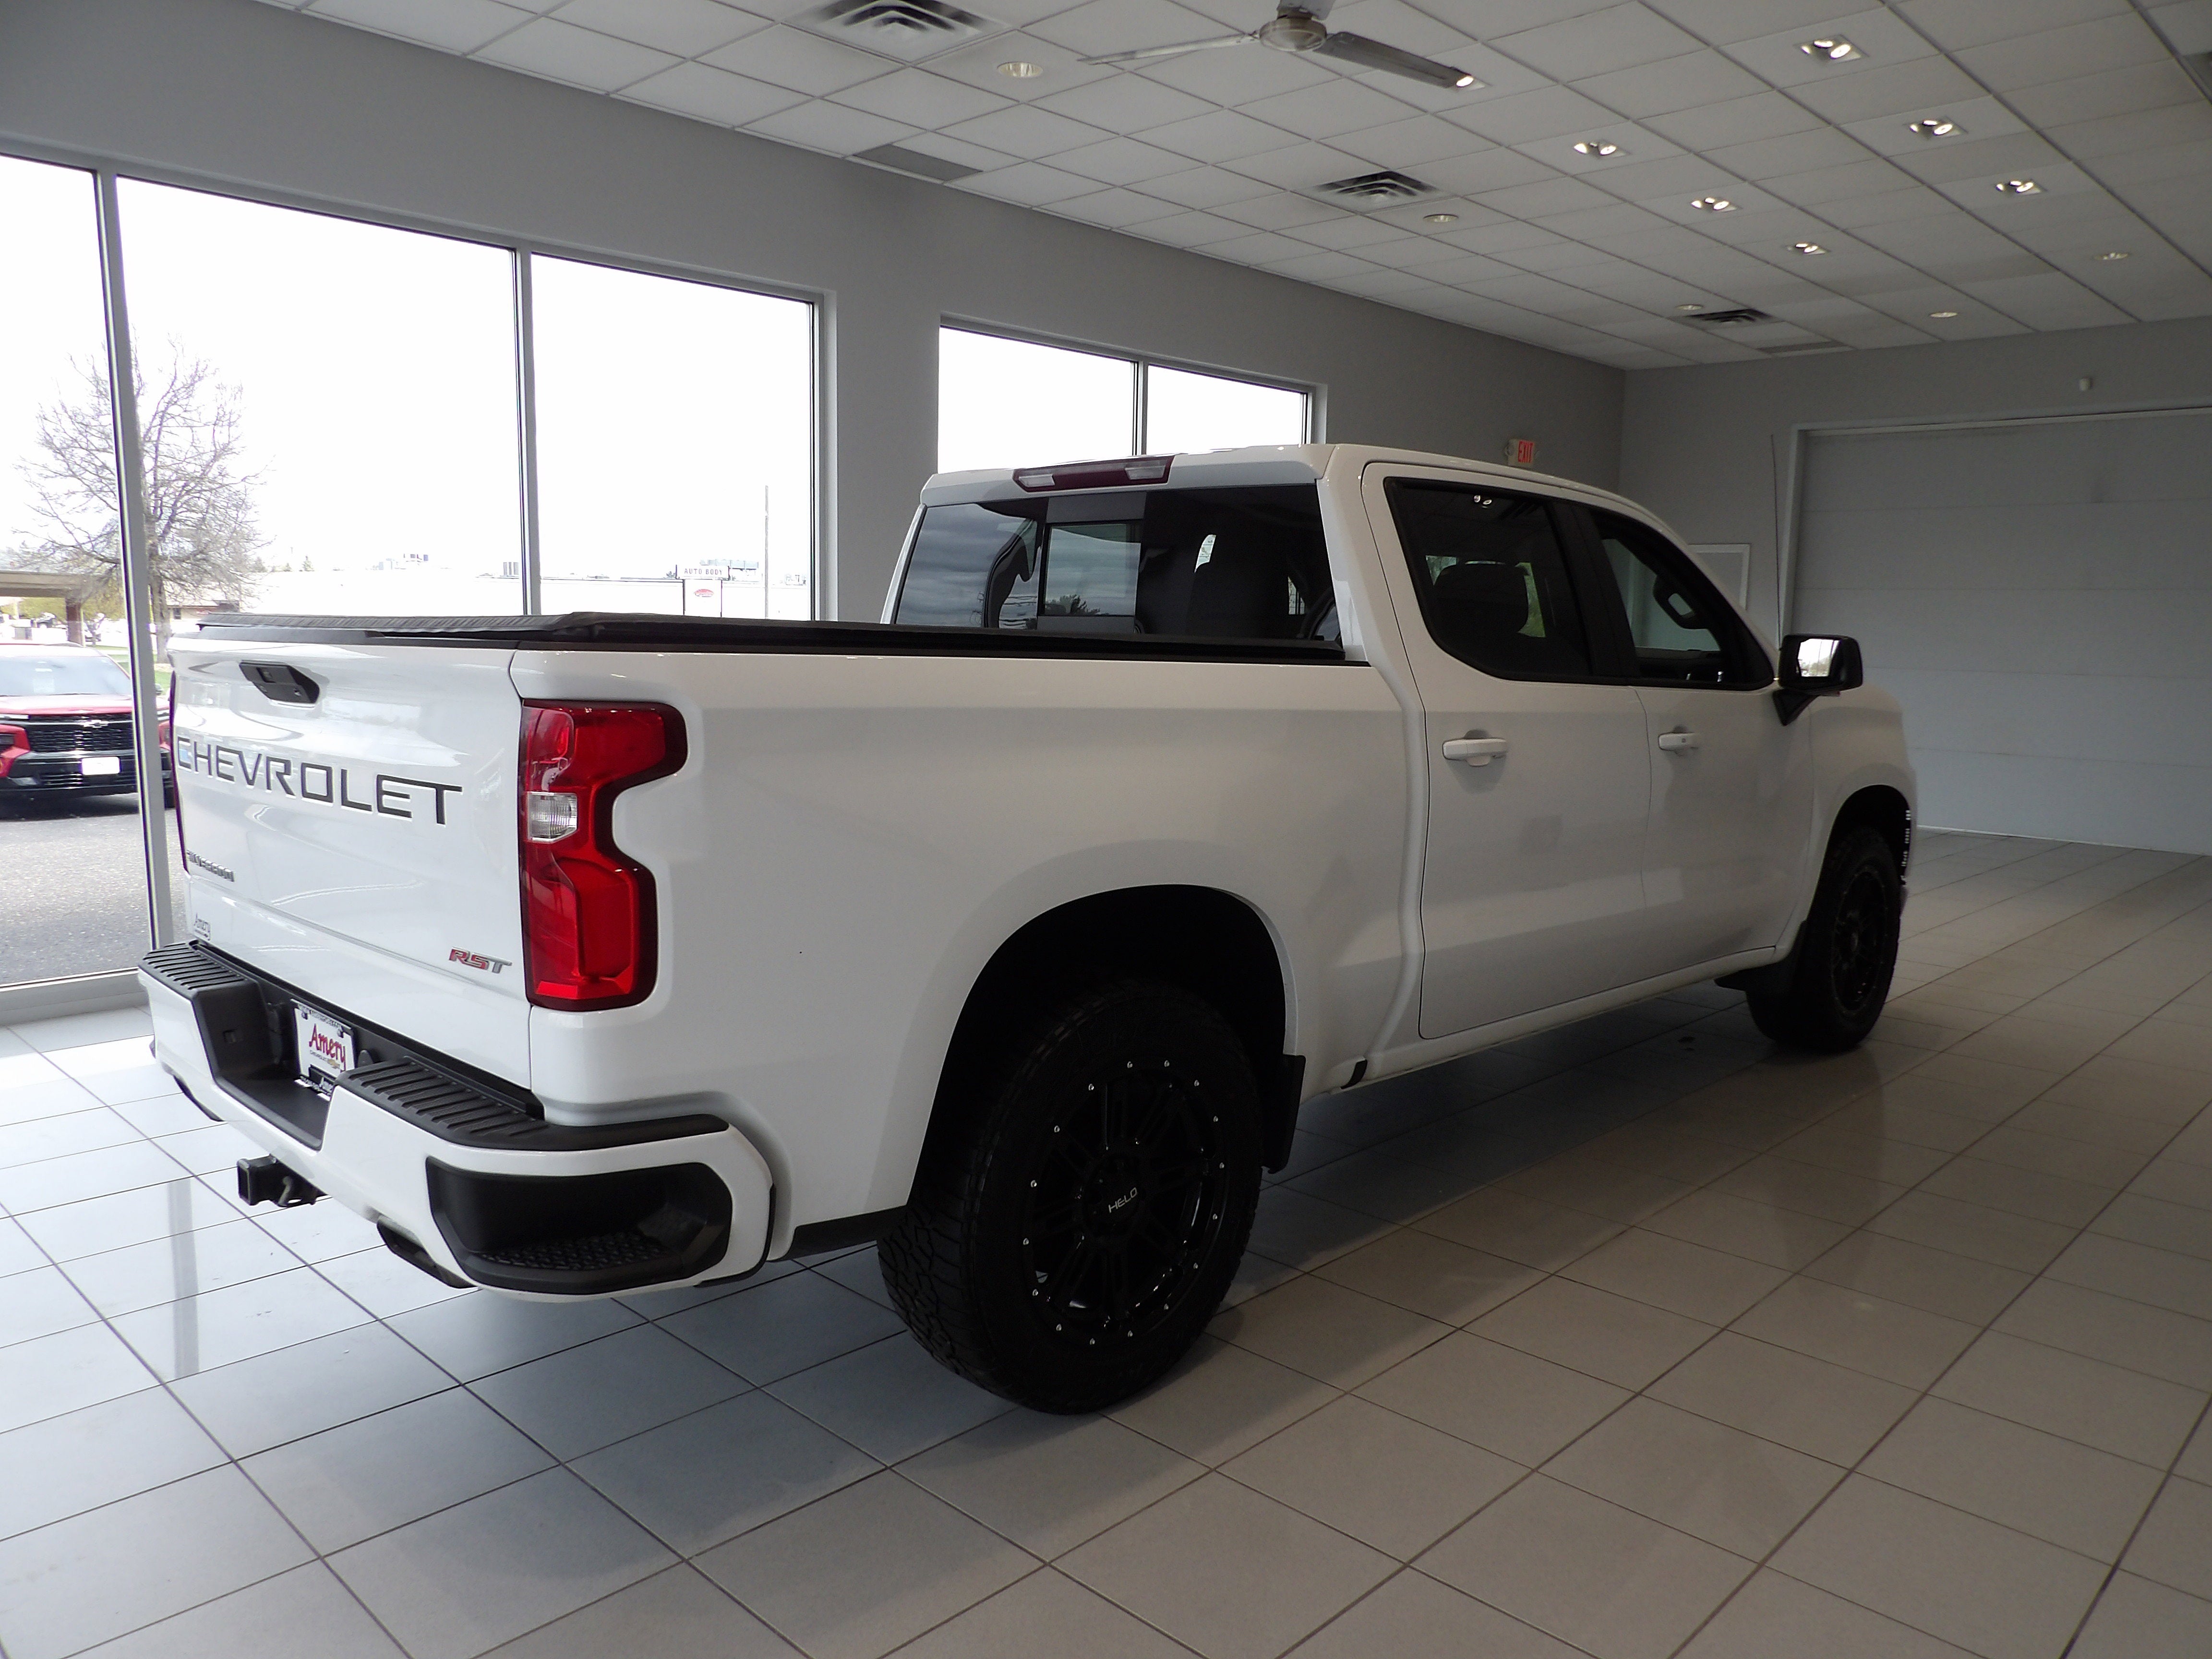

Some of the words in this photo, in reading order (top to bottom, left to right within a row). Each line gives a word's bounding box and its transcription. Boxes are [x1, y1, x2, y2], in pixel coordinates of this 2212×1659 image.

[1518, 441, 1533, 462] EXIT
[177, 736, 463, 826] CHEVROLET
[449, 947, 512, 974] RST
[309, 1023, 346, 1073] Amery
[1108, 1187, 1138, 1214] HELO
